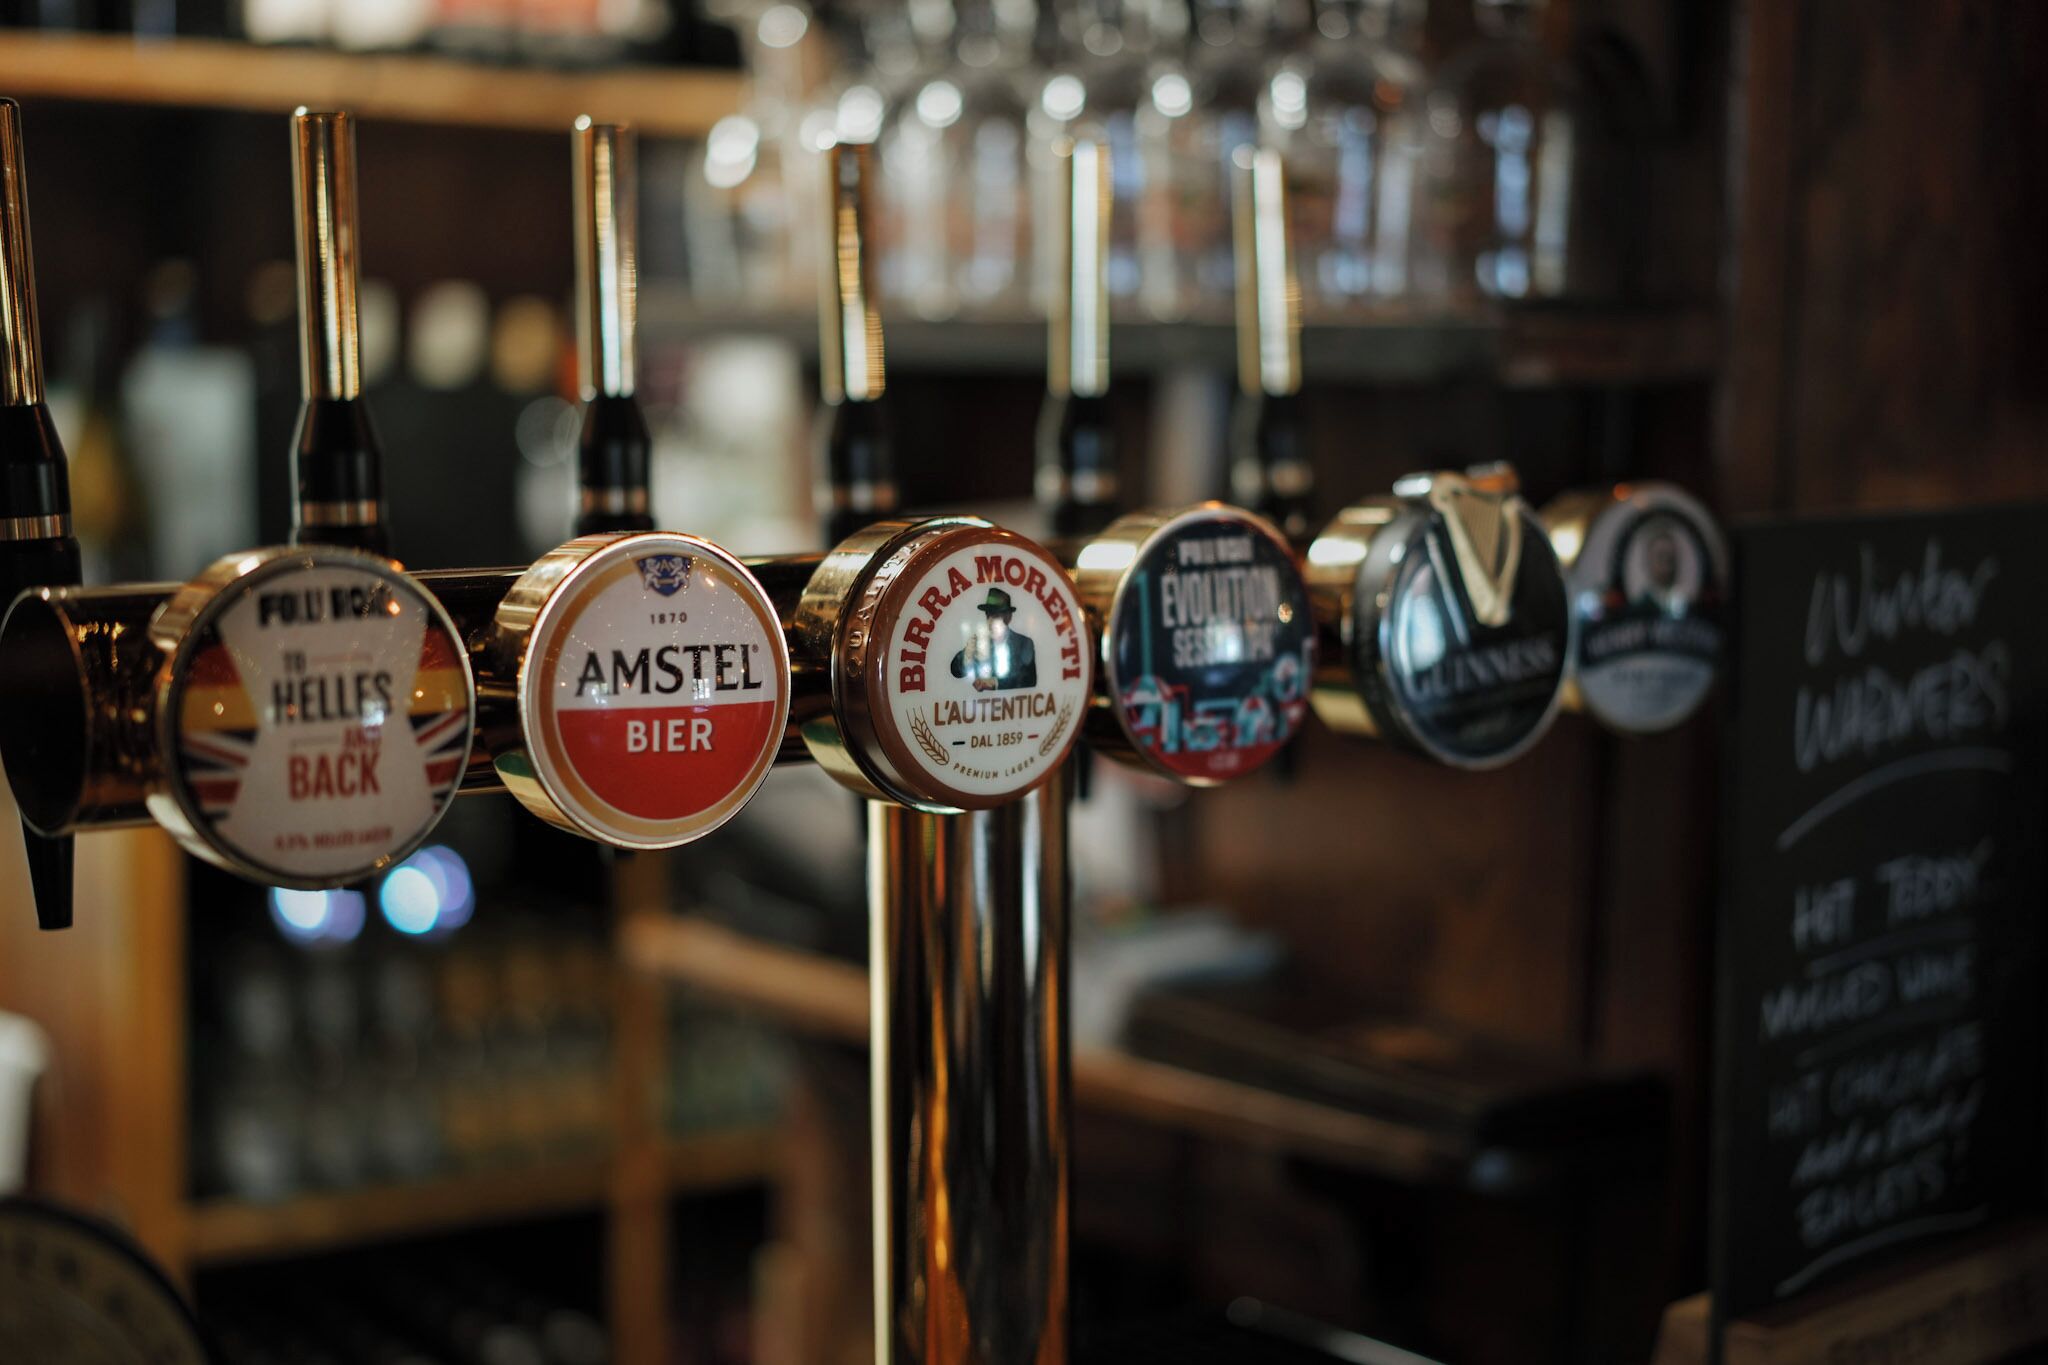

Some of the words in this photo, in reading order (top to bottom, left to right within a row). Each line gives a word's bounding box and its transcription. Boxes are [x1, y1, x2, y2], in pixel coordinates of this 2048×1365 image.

[1161, 565, 1281, 628] EVOLUTION
[650, 611, 688, 625] 1870
[899, 567, 973, 693] BIRRA
[974, 555, 1081, 681] MORETTI
[283, 652, 307, 672] TO
[1173, 623, 1245, 668] SESS
[574, 643, 762, 697] AMSTEL
[271, 671, 393, 724] HELLES
[934, 692, 1057, 726] L'AUTENTICA
[626, 718, 713, 753] BIER
[970, 735, 993, 749] DAL
[996, 731, 1024, 747] 1859
[288, 750, 382, 803] BACK
[953, 762, 999, 780] PREMIUM
[1004, 756, 1035, 777] LAGER
